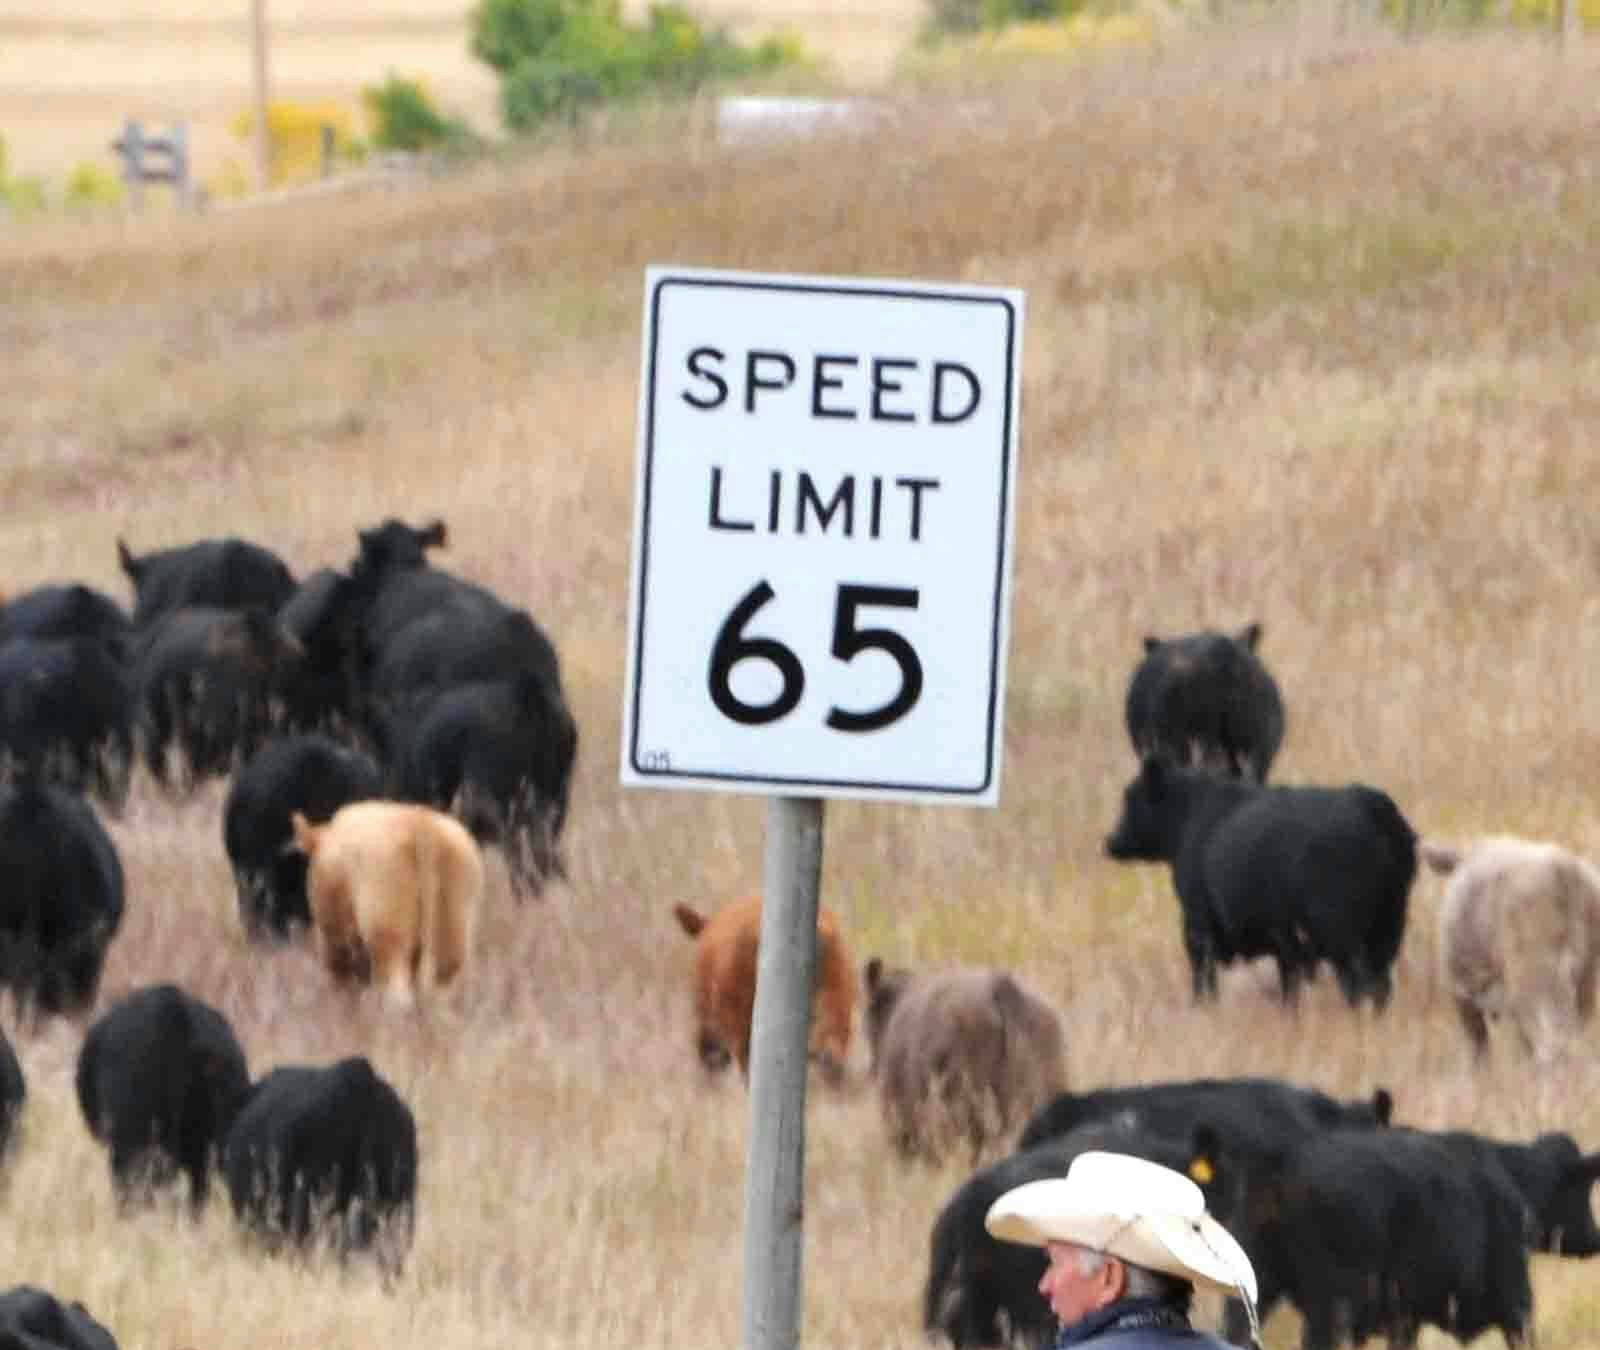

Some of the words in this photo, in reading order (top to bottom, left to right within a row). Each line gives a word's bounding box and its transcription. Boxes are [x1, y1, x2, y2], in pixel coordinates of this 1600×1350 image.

[681, 346, 982, 425] SPEED
[707, 466, 940, 541] LIMIT
[707, 579, 924, 733] 65
